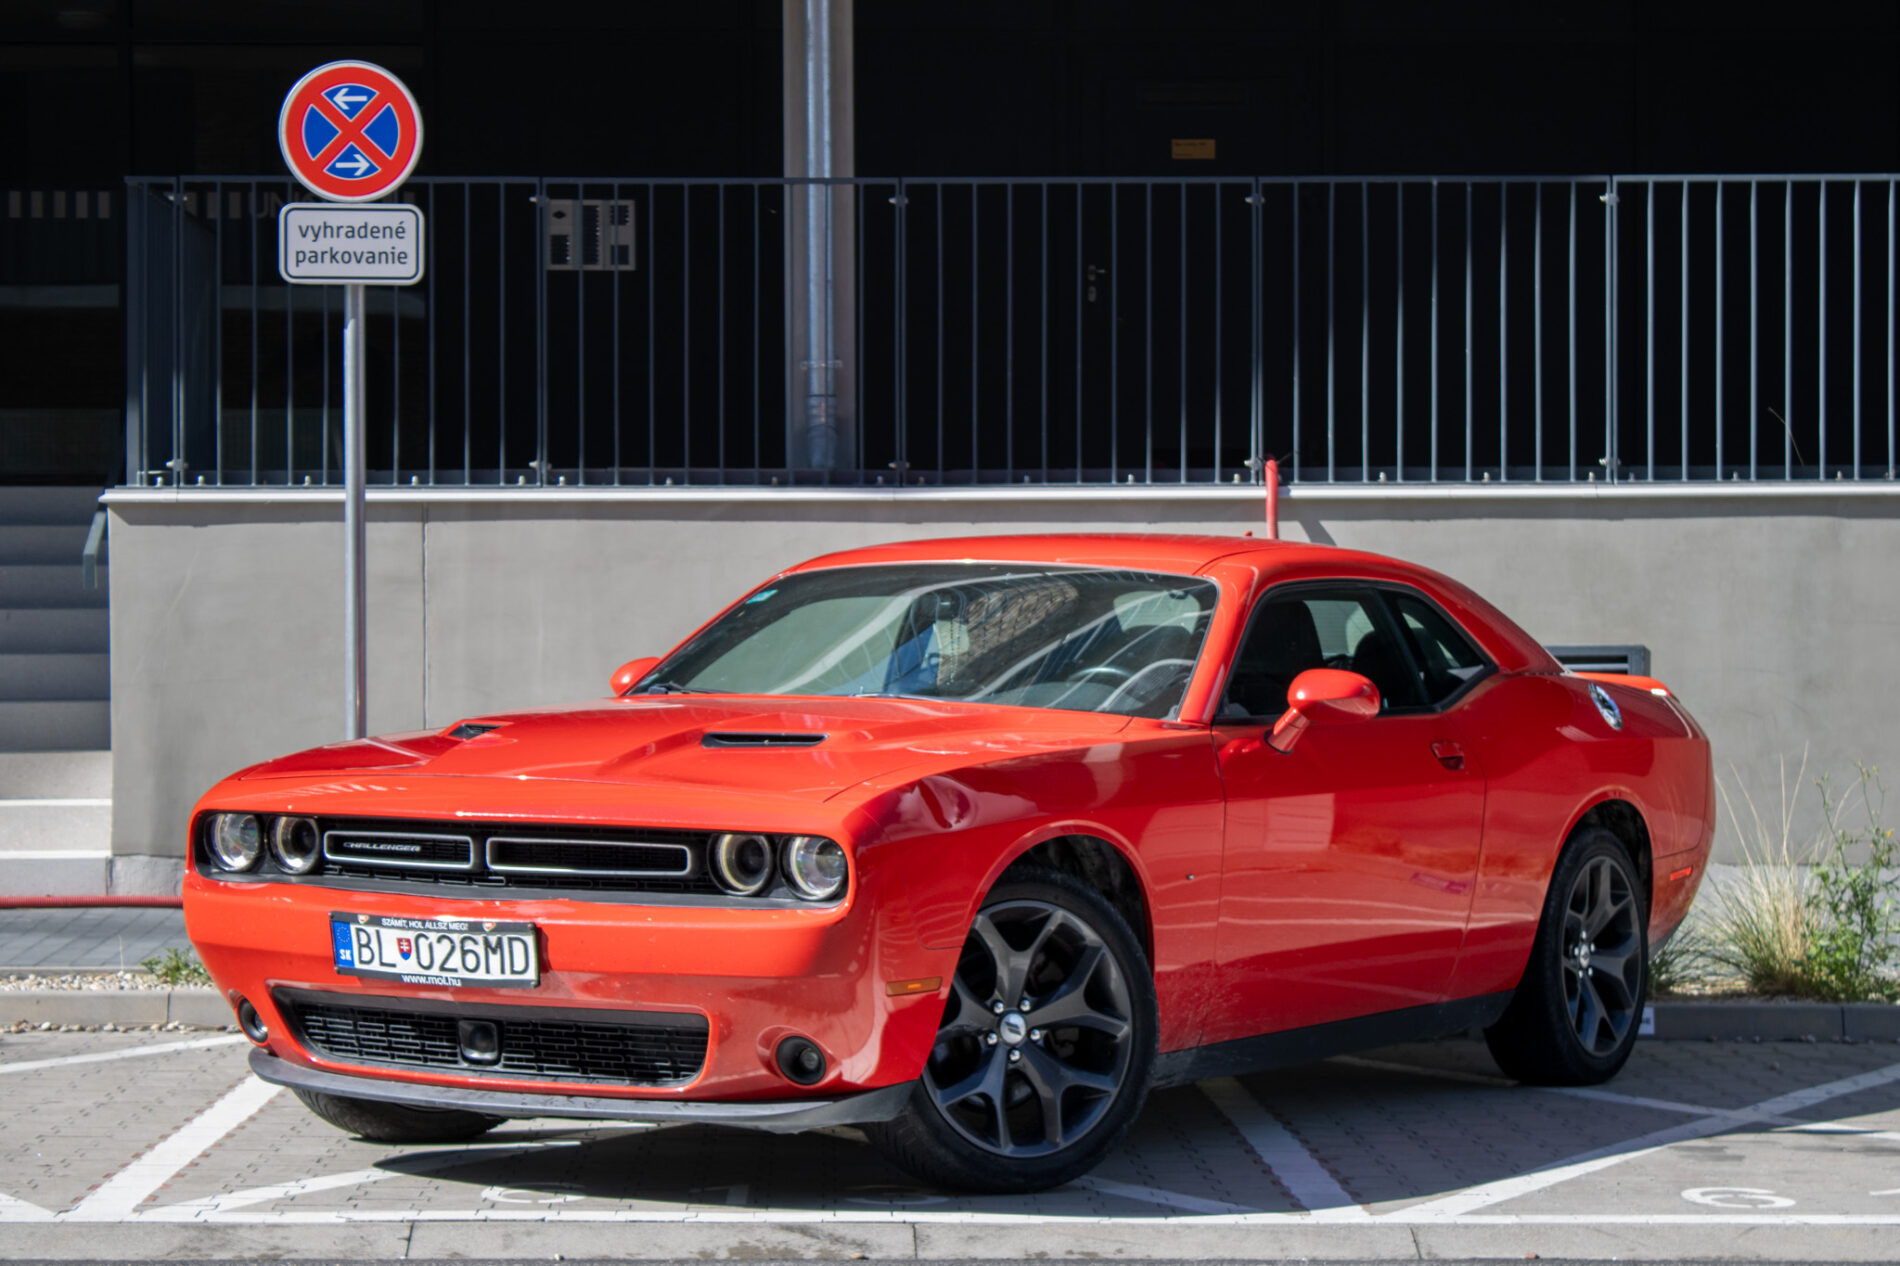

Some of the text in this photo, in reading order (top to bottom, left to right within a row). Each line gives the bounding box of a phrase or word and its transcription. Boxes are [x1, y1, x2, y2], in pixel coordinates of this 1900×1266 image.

[298, 221, 406, 242] vyhradené
[295, 246, 408, 267] parkovanie
[343, 841, 421, 852] CHALLENGER
[408, 921, 424, 929] HOL
[339, 949, 352, 961] SK
[355, 927, 530, 975] BL 026MD
[401, 974, 461, 987] www.mol.hu
